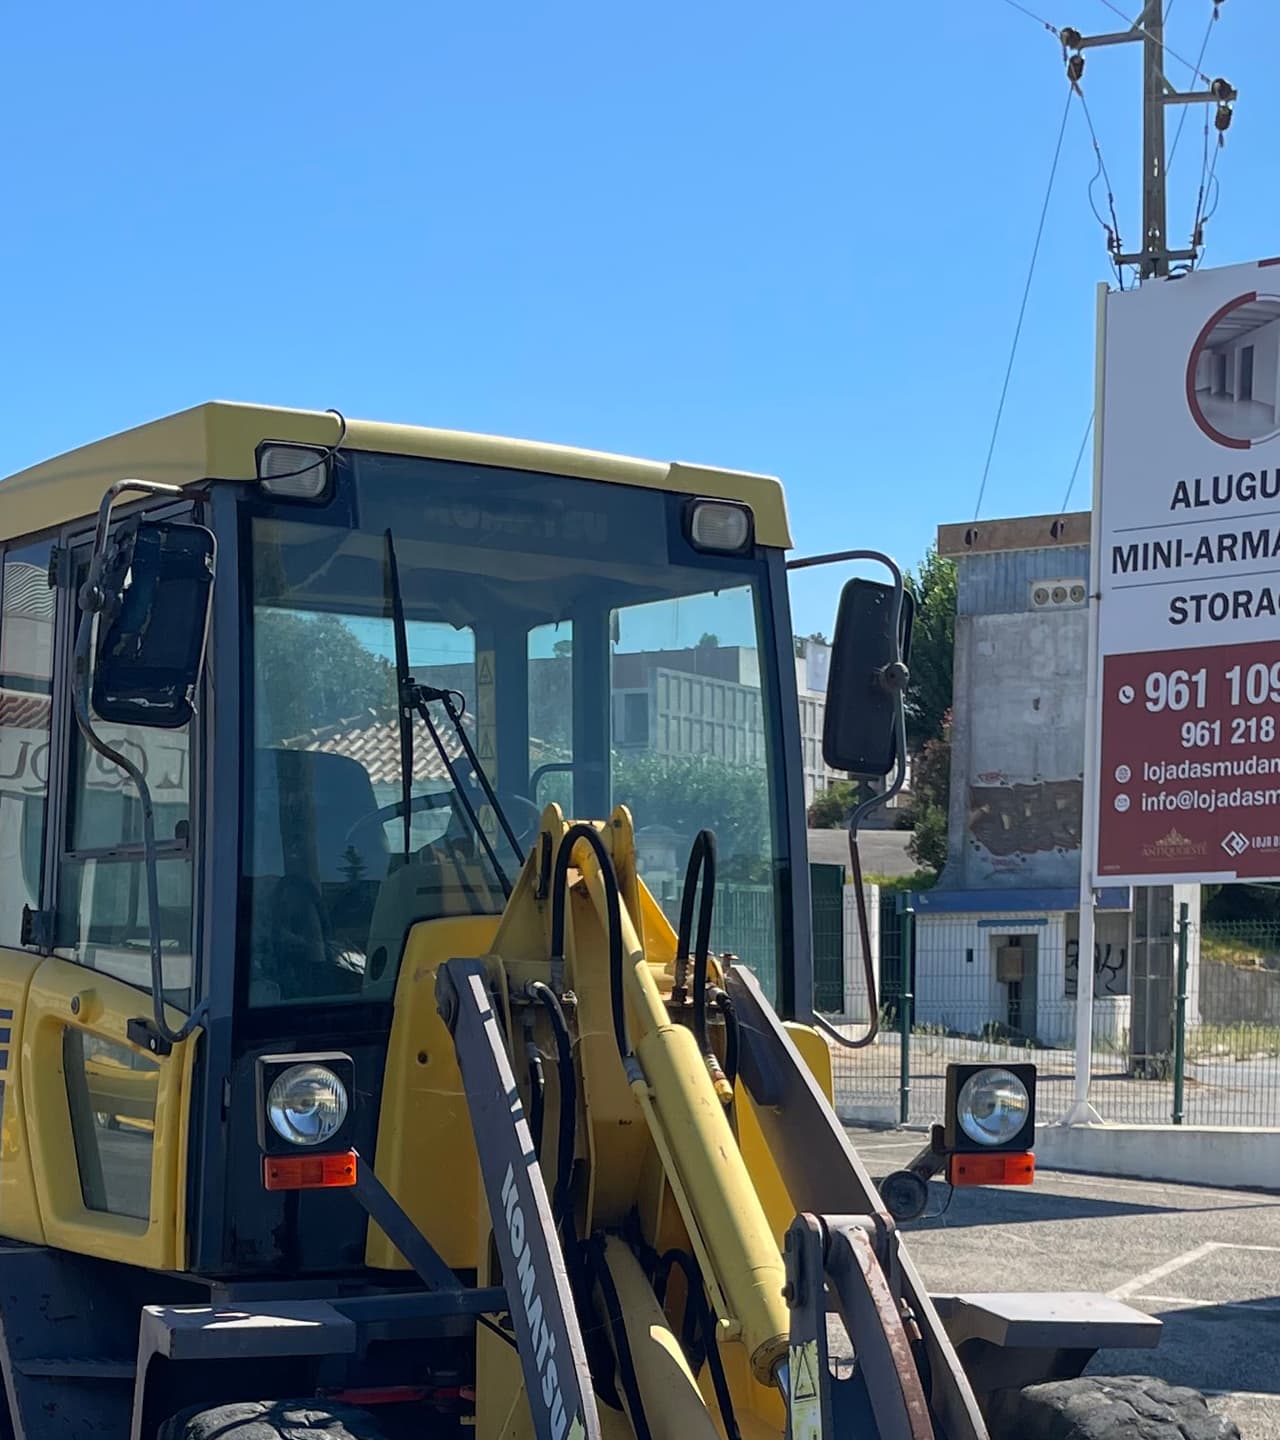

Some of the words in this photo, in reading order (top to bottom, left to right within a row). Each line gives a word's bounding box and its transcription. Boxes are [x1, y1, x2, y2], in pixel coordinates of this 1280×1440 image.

[1144, 668, 1207, 712] 961
[1181, 719, 1221, 748] 961
[1231, 715, 1275, 744] 218
